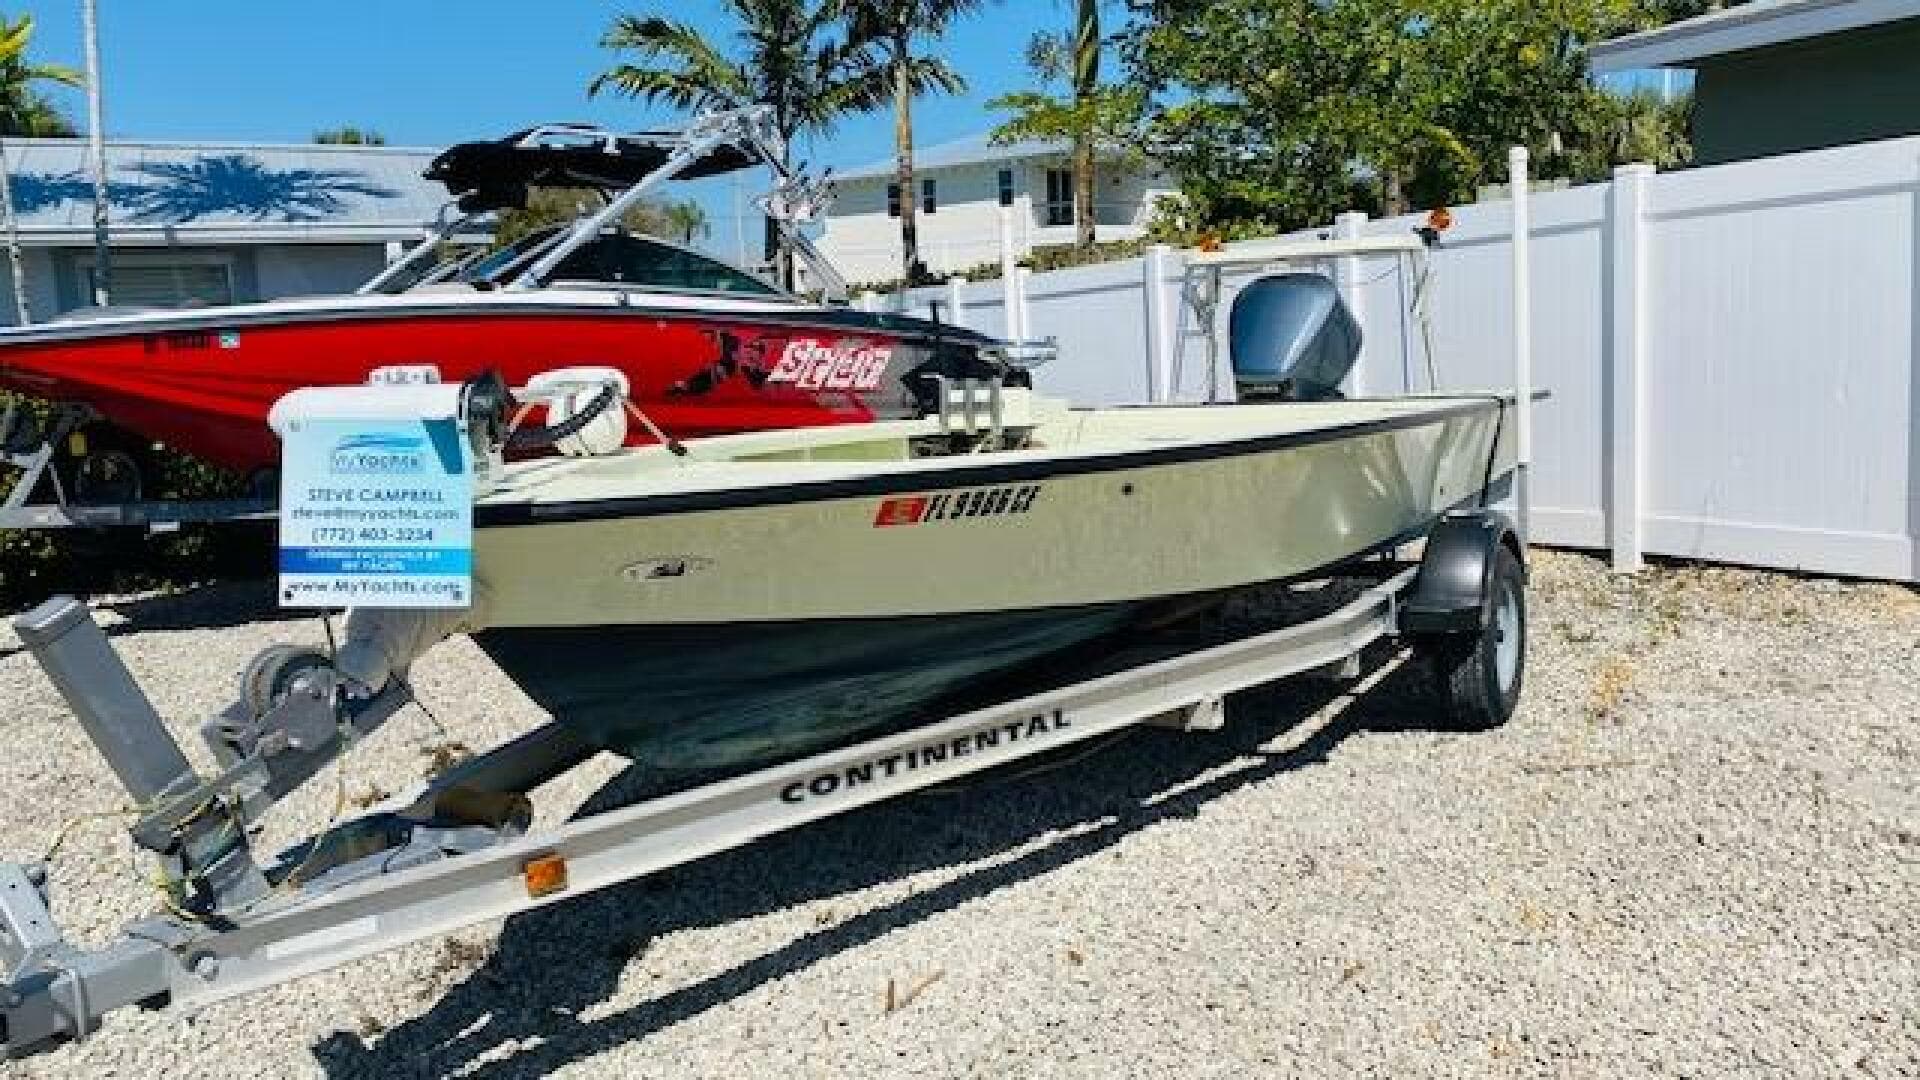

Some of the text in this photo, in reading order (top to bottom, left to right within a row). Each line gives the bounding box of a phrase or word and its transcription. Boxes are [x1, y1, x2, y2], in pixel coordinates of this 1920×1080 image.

[308, 488, 444, 502] STEVE CAMPBELL
[312, 527, 354, 543] (772)
[779, 708, 1072, 804] CONTINENTAL
